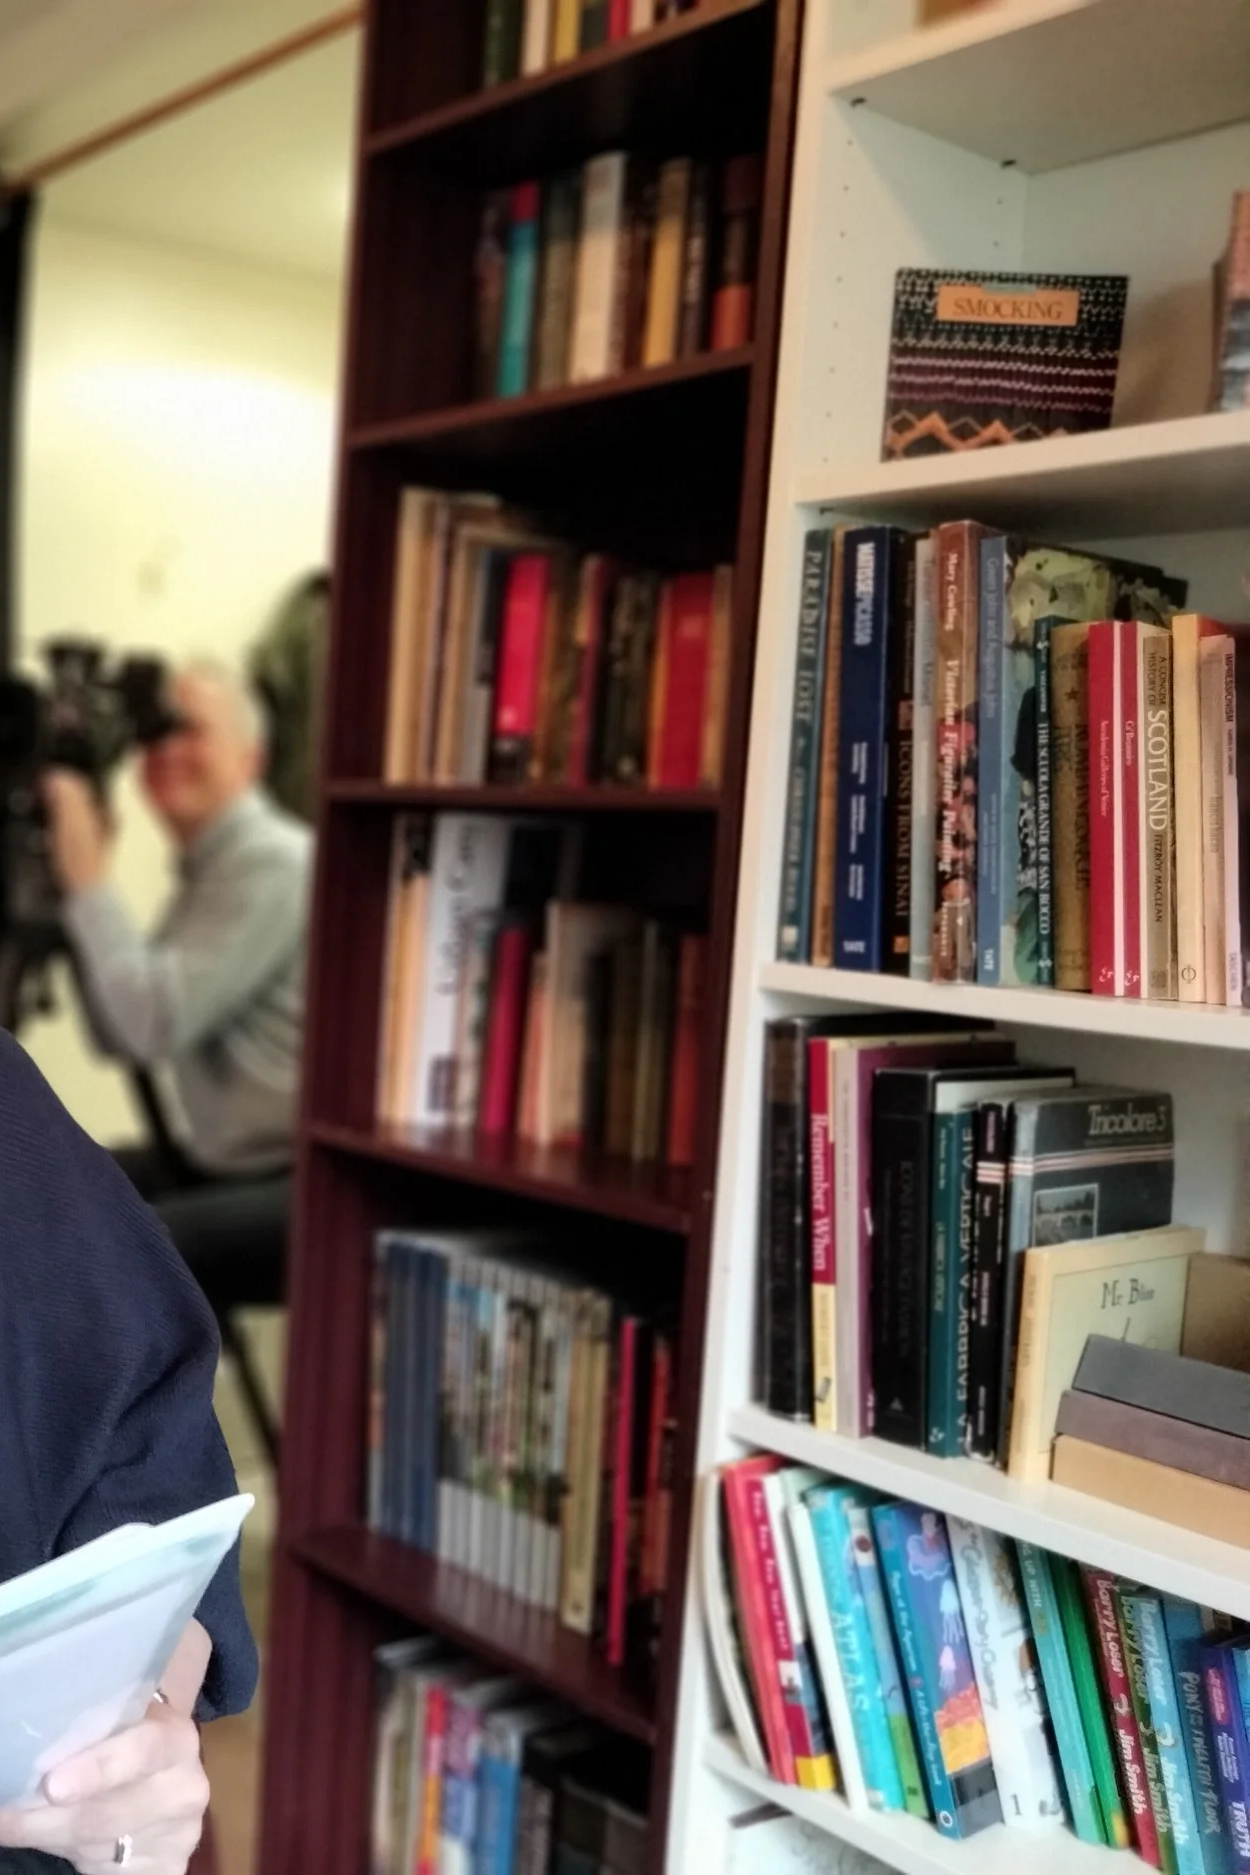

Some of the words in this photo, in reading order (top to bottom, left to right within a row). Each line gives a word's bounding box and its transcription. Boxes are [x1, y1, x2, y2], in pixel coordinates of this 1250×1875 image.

[953, 296, 1063, 321] SMOCKING
[945, 552, 958, 582] Mary
[799, 551, 823, 657] PARADISE
[944, 585, 958, 632] Cowling
[1149, 652, 1158, 693] HISTORY
[1159, 656, 1167, 664] A
[795, 671, 814, 721] LOST
[944, 660, 960, 725] Victorian
[1149, 694, 1157, 706] OF
[1159, 666, 1168, 706] CONCISE
[1224, 653, 1234, 723] IMPRESSIONISM
[1037, 723, 1049, 746] THE
[897, 740, 912, 799] ICONS
[940, 731, 960, 804] Figurative
[1037, 748, 1050, 793] SCUOLA
[1147, 709, 1170, 832] SCOTLAND
[896, 804, 911, 859] FROM
[938, 810, 957, 872] Painting
[1038, 795, 1050, 845] GRANDE
[1039, 847, 1050, 864] OF
[1153, 834, 1165, 873] FITZROY
[895, 864, 910, 916] SINAI
[1038, 866, 1050, 890] SAN
[1154, 874, 1165, 923] MACLEAN
[1039, 893, 1050, 935] ROCCO
[1087, 1102, 1157, 1136] Tricolore
[810, 1113, 830, 1213] Remember
[812, 1217, 832, 1271] When
[1024, 1562, 1036, 1576] UP
[1028, 1578, 1043, 1607] WITH
[1097, 1580, 1117, 1630] Barry
[832, 1611, 866, 1710] ATLAS
[1106, 1632, 1125, 1678] Loser
[1178, 1671, 1203, 1713] PONY
[1118, 1729, 1135, 1760] Jim
[1143, 1747, 1159, 1778] Jim
[1125, 1762, 1148, 1815] Smith
[1160, 1756, 1178, 1789] Jim
[1149, 1781, 1170, 1833] Smith
[1167, 1792, 1189, 1845] Smith
[1231, 1800, 1250, 1858] TRUTH
